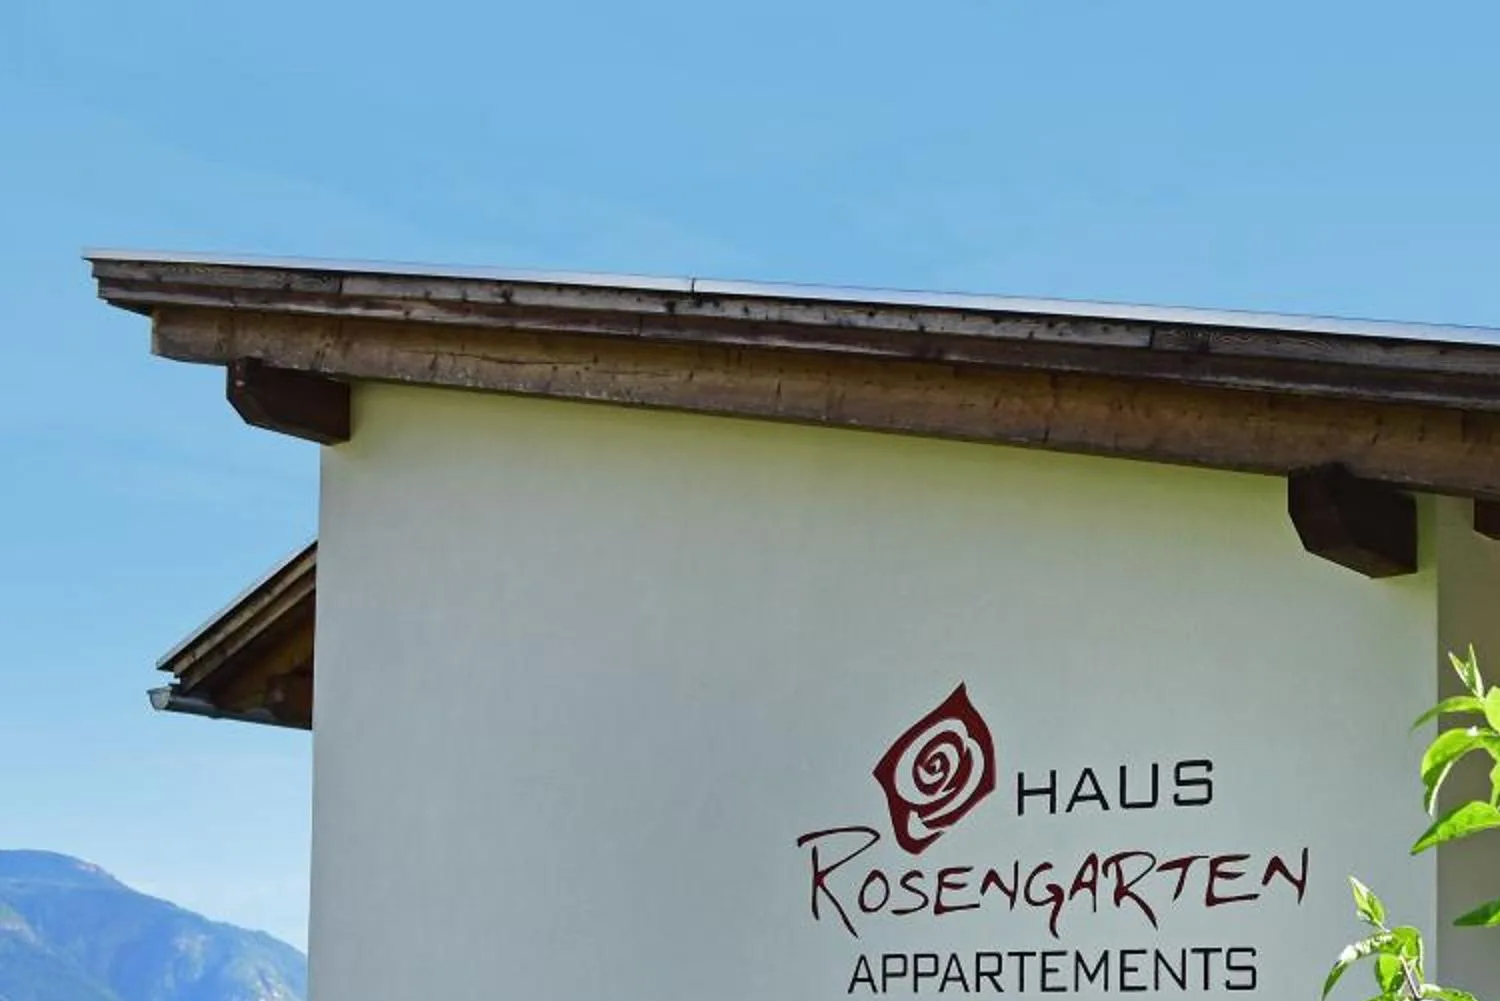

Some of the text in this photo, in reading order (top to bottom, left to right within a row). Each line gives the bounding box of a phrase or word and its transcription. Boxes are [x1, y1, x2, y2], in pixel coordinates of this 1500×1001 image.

[1017, 760, 1214, 815] HAUS
[797, 826, 1309, 938] ROSENGARTEN
[847, 947, 1257, 994] APPARTEMENTS
